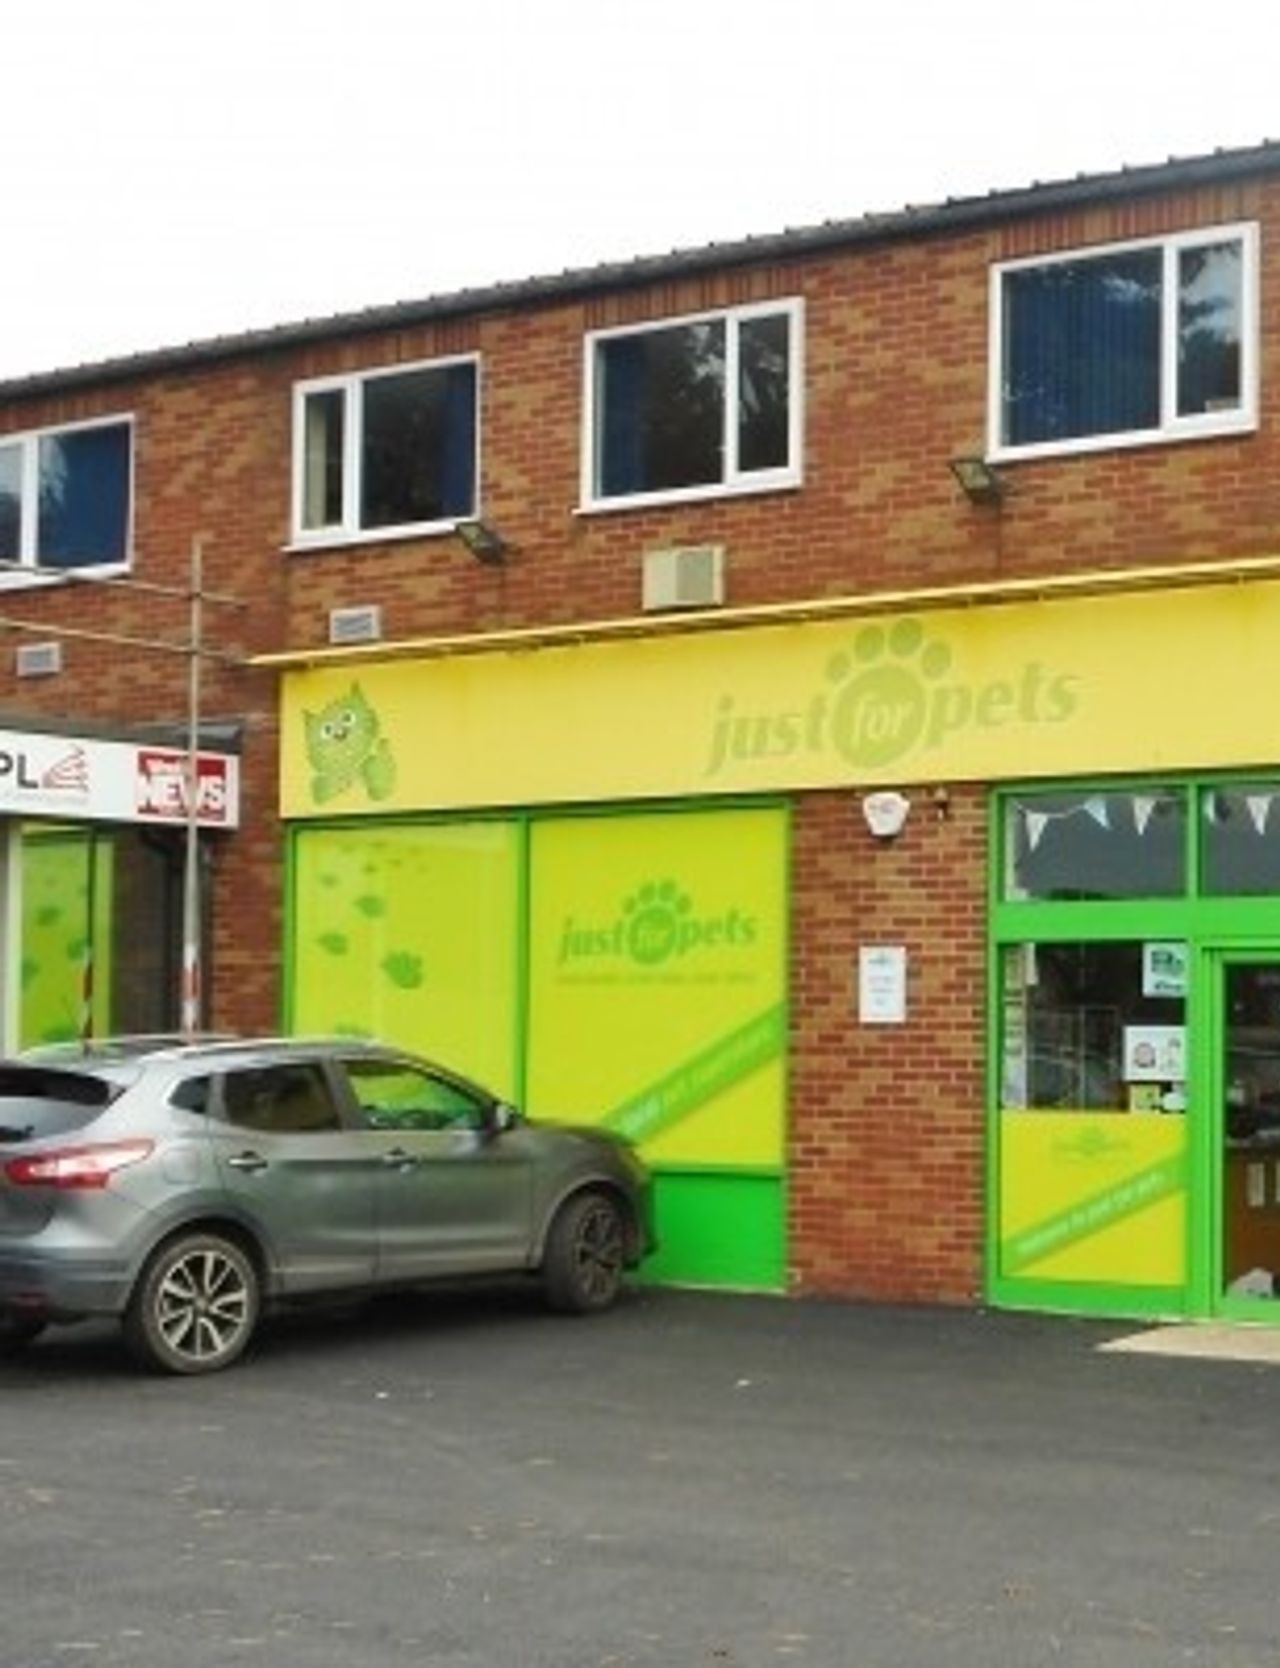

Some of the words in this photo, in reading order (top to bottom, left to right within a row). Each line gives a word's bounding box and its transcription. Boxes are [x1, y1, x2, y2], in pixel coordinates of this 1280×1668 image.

[706, 694, 829, 777] just
[850, 697, 904, 745] for
[925, 662, 1080, 747] pets
[558, 917, 624, 964] just
[678, 909, 757, 955] pets
